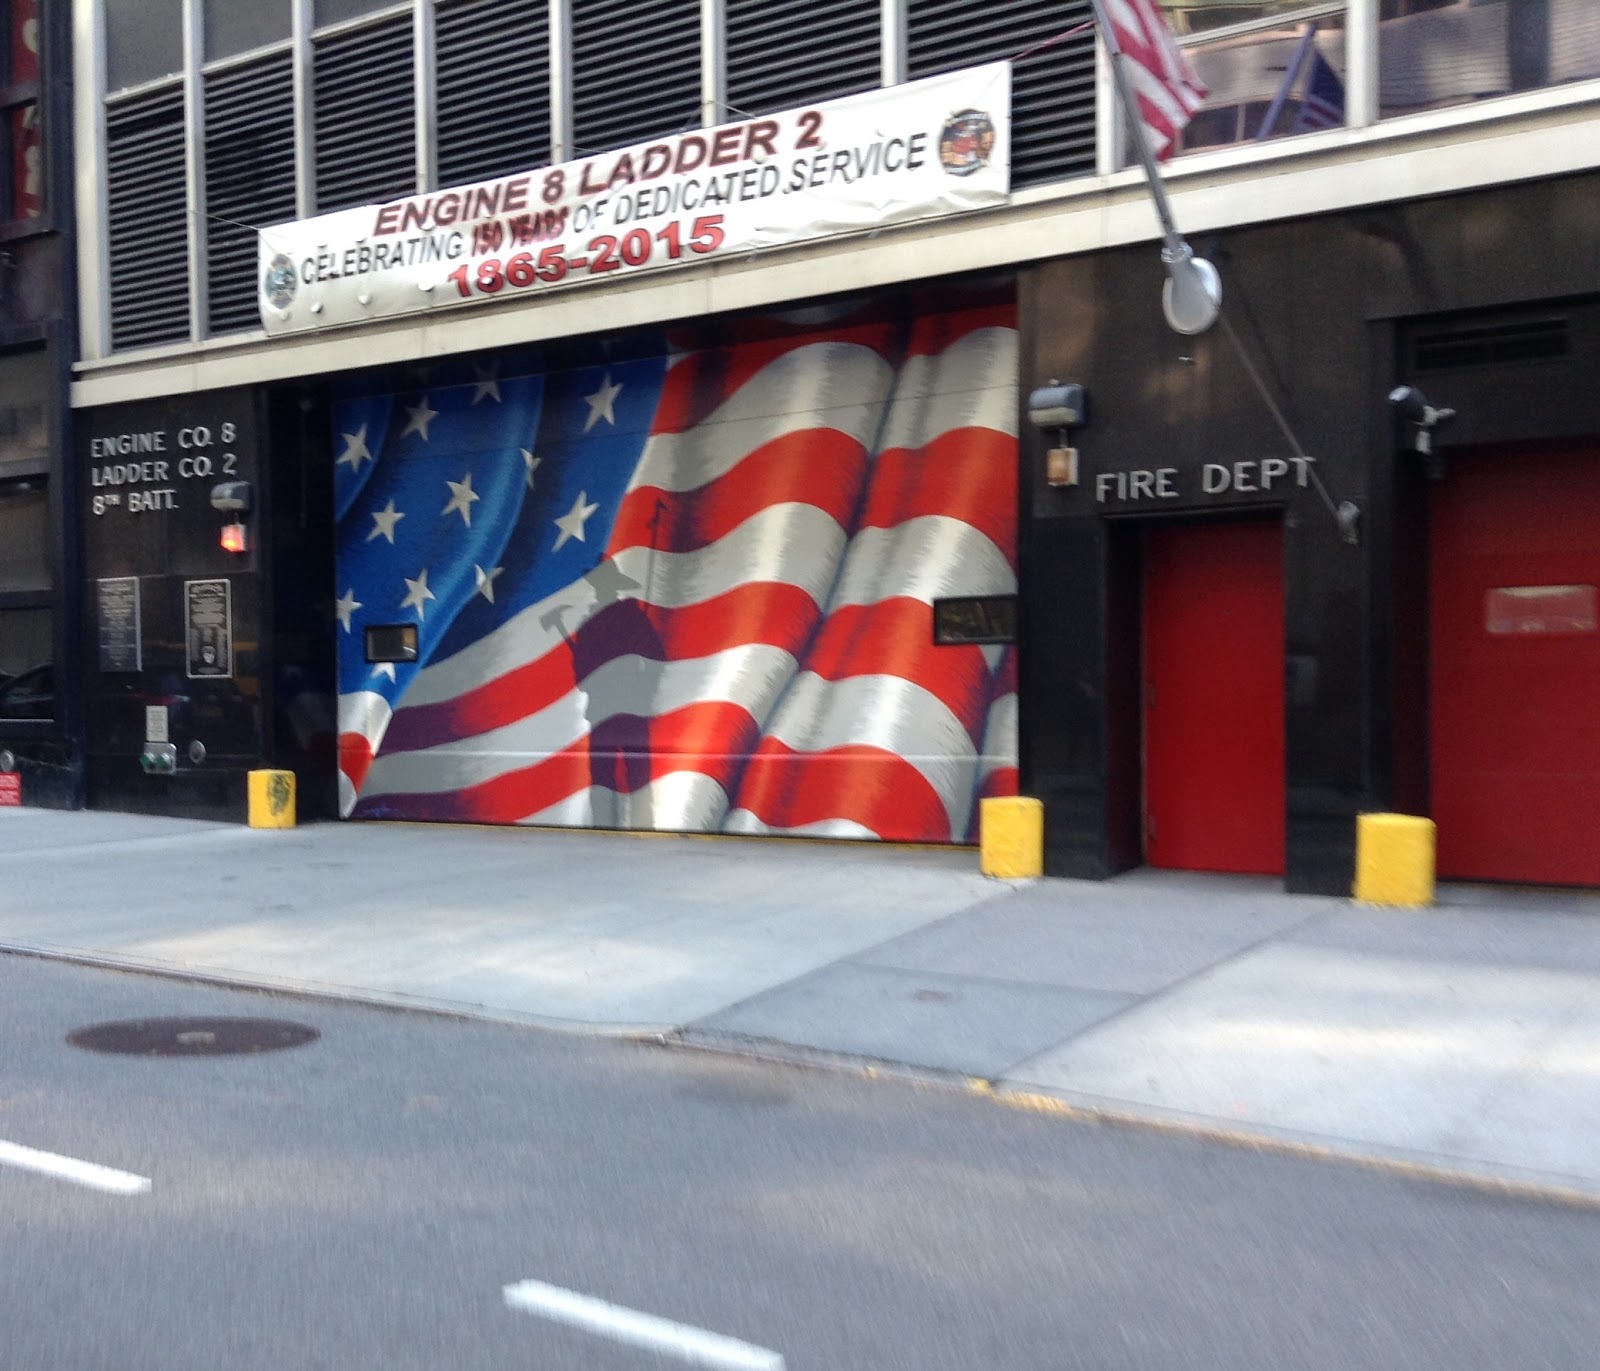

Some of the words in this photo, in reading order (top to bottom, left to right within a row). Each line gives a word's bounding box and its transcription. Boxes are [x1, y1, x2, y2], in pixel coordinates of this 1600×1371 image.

[373, 177, 531, 236] ENGINE
[540, 169, 566, 205] 8
[576, 118, 781, 197] LADDER
[794, 110, 824, 151] 2
[301, 231, 463, 285] CELEBRATING
[572, 199, 609, 233] OF
[613, 164, 780, 224] DEDICATED
[788, 131, 929, 192] SERVICE
[447, 213, 725, 299] 1865-2015
[91, 431, 168, 459] ENGINE
[177, 426, 214, 449] CO.
[220, 422, 237, 444] 8
[91, 460, 170, 487] LADDER
[178, 455, 215, 479] CO.
[222, 452, 238, 475] 2
[1096, 467, 1180, 503] FIRE
[1202, 455, 1317, 495] DEPT
